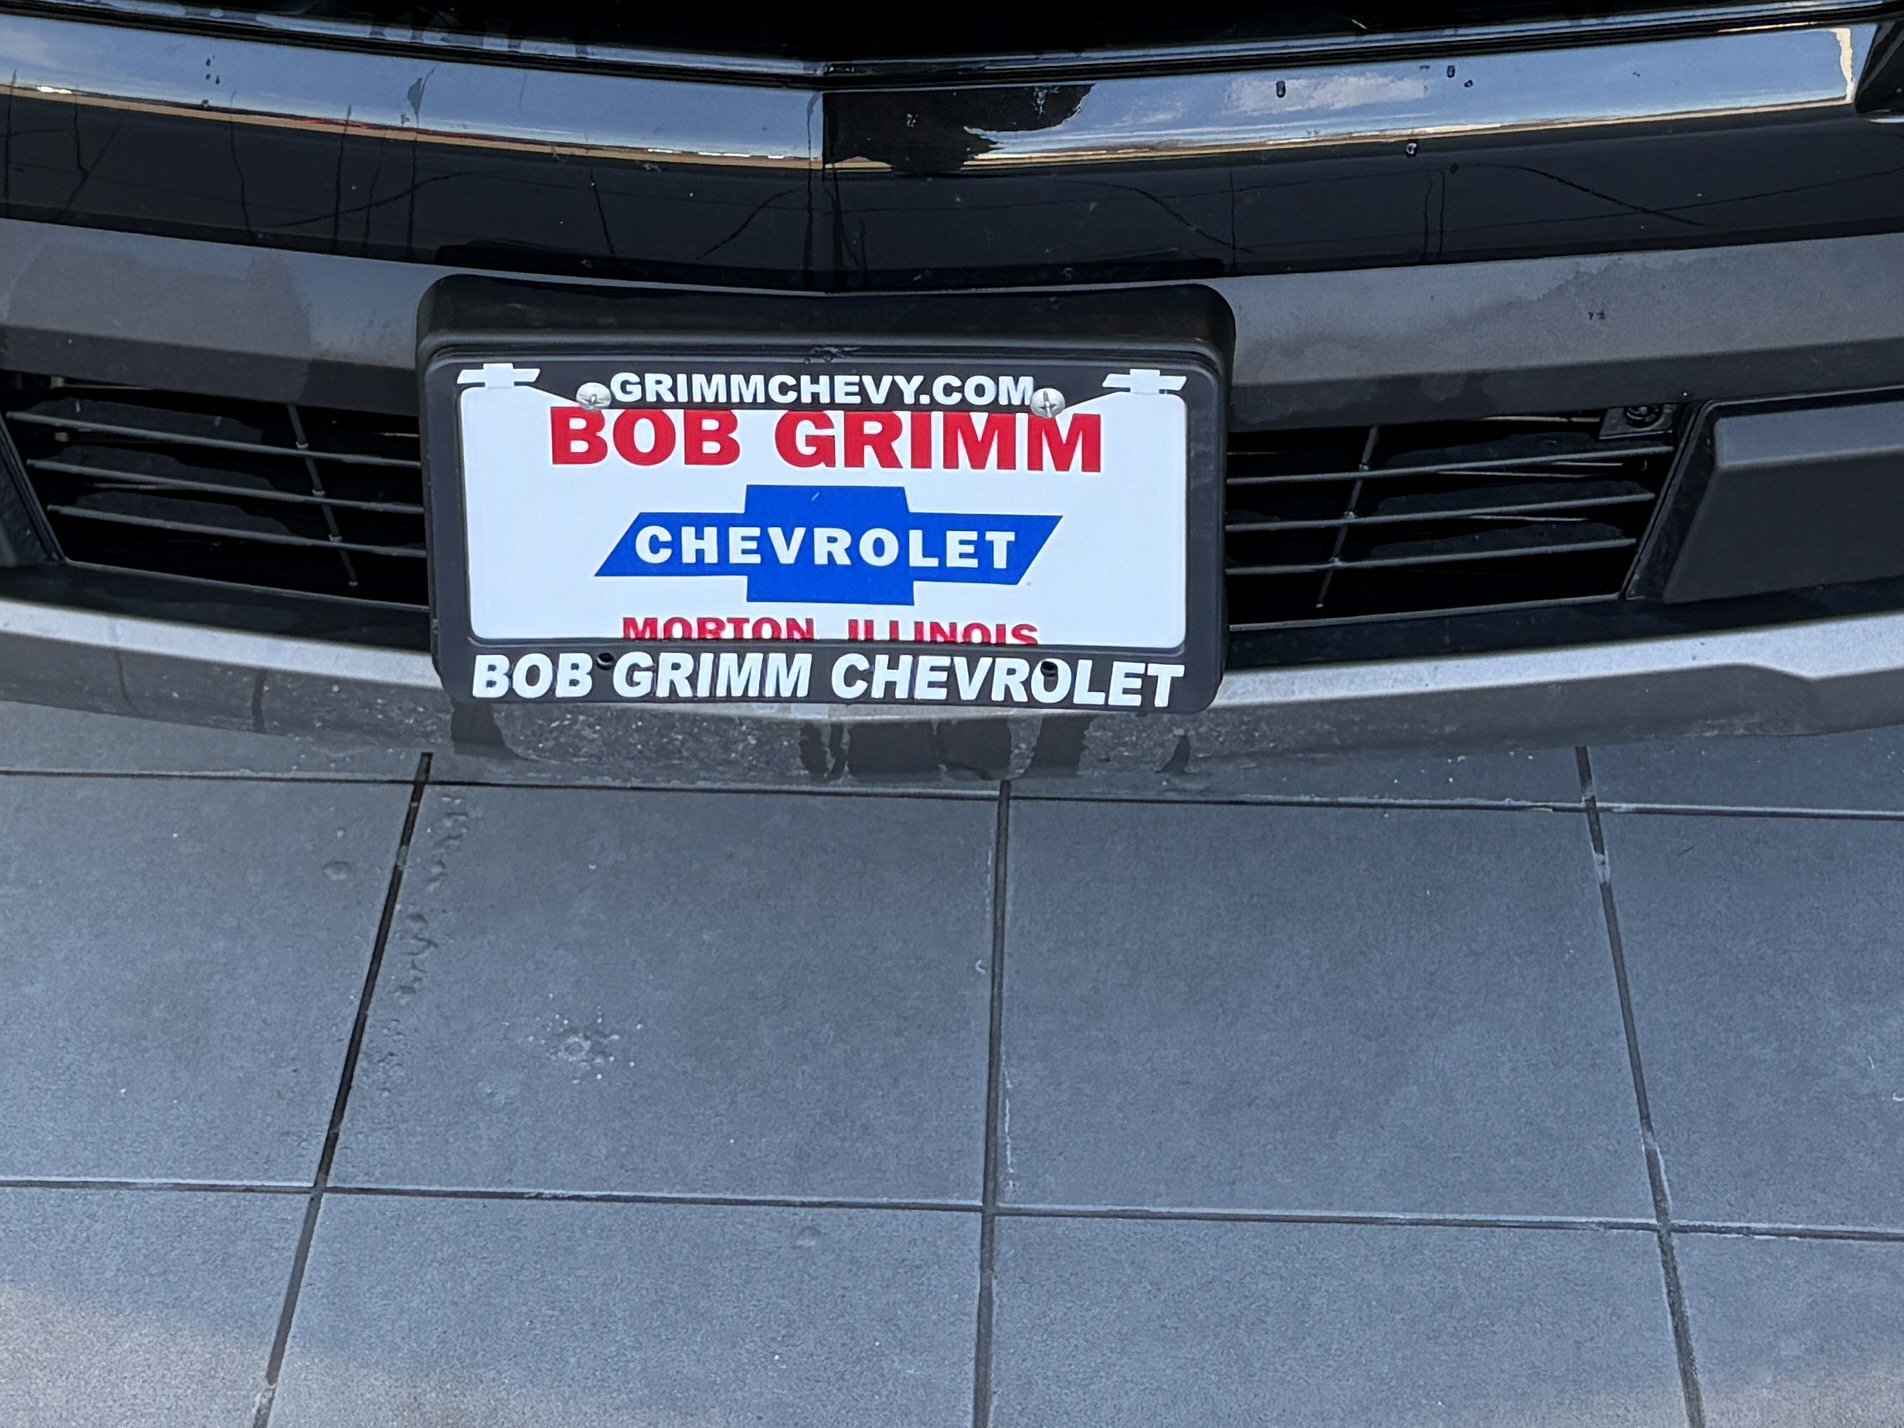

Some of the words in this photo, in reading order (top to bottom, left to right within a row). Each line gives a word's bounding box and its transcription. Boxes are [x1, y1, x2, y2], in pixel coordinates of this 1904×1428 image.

[610, 371, 1034, 406] GRIMMCHEVY.COM
[550, 406, 741, 466] BOB
[774, 409, 1102, 473] GRIMM
[635, 524, 1018, 571] CHEVROLET
[622, 616, 815, 641] MORTON
[847, 618, 1039, 645] ILLINOIS
[472, 652, 594, 699] BOB
[612, 651, 812, 700] GRIMM
[830, 651, 1184, 708] CHEVROLET
